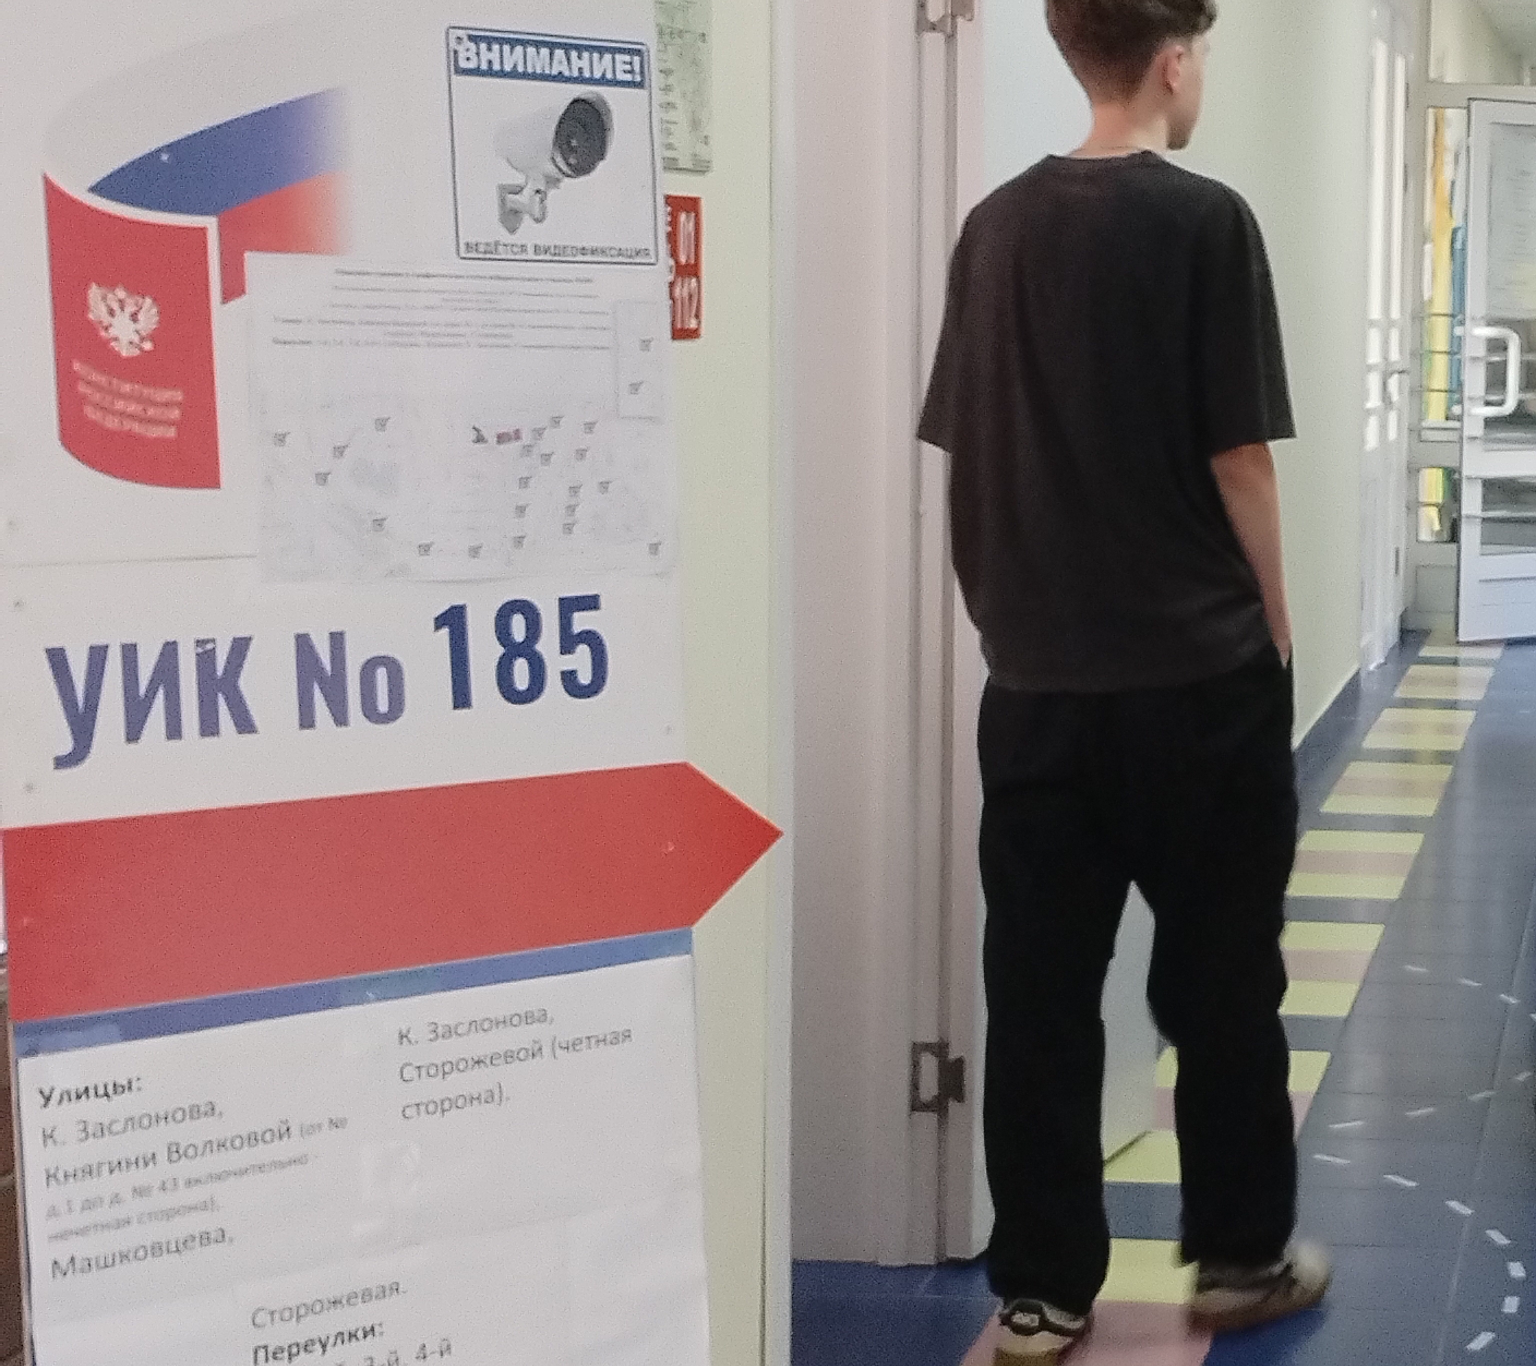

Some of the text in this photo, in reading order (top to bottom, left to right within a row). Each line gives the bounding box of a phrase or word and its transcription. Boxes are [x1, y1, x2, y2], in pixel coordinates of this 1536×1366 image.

[458, 40, 642, 83] ВНИМАНИЕ!
[464, 240, 652, 260] ВЕДЁТСЯ ВИДЕОФИКСАЦИЯ
[45, 636, 260, 771] УИК
[433, 592, 610, 712] 185
[397, 1007, 555, 1046] К. Заслонова,
[400, 1028, 634, 1083] Сторожевой (четная
[38, 1077, 142, 1109] Улицы:
[77, 1101, 223, 1143] Заслонова,
[44, 1151, 157, 1188] Княгини
[166, 1118, 292, 1165] Волковой
[51, 1227, 234, 1280] Машковцева,
[415, 1337, 452, 1363] 4-й
